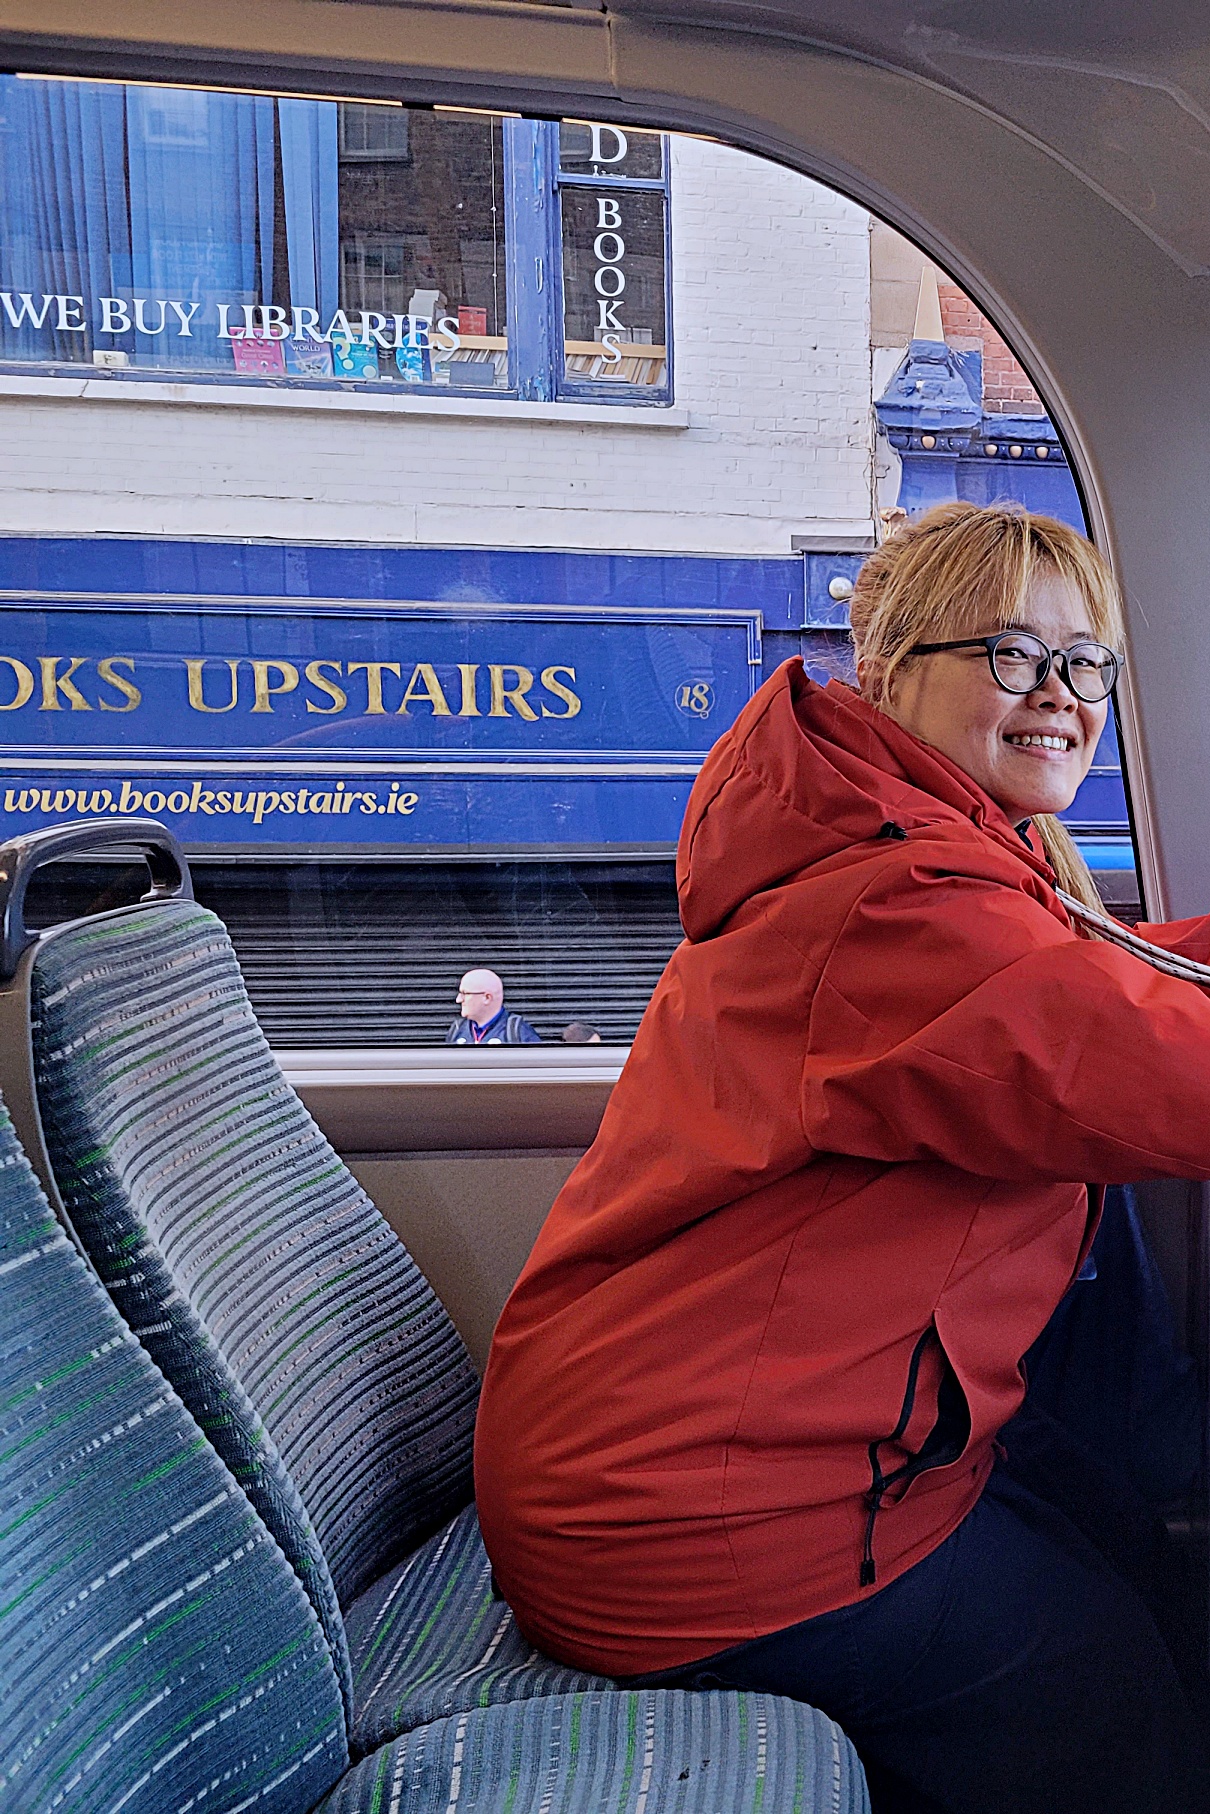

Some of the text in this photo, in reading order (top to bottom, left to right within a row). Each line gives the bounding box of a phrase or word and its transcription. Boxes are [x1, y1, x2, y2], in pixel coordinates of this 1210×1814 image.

[588, 125, 628, 163] D
[593, 197, 626, 364] BOOKS
[0, 292, 87, 332] WE
[99, 297, 200, 337] BUY
[216, 303, 461, 352] LIBRARIES
[292, 344, 321, 352] WORLD
[182, 660, 582, 722] UPSTAIRS
[680, 682, 710, 714] 18
[4, 781, 418, 824] www.booksupstairs.ie
